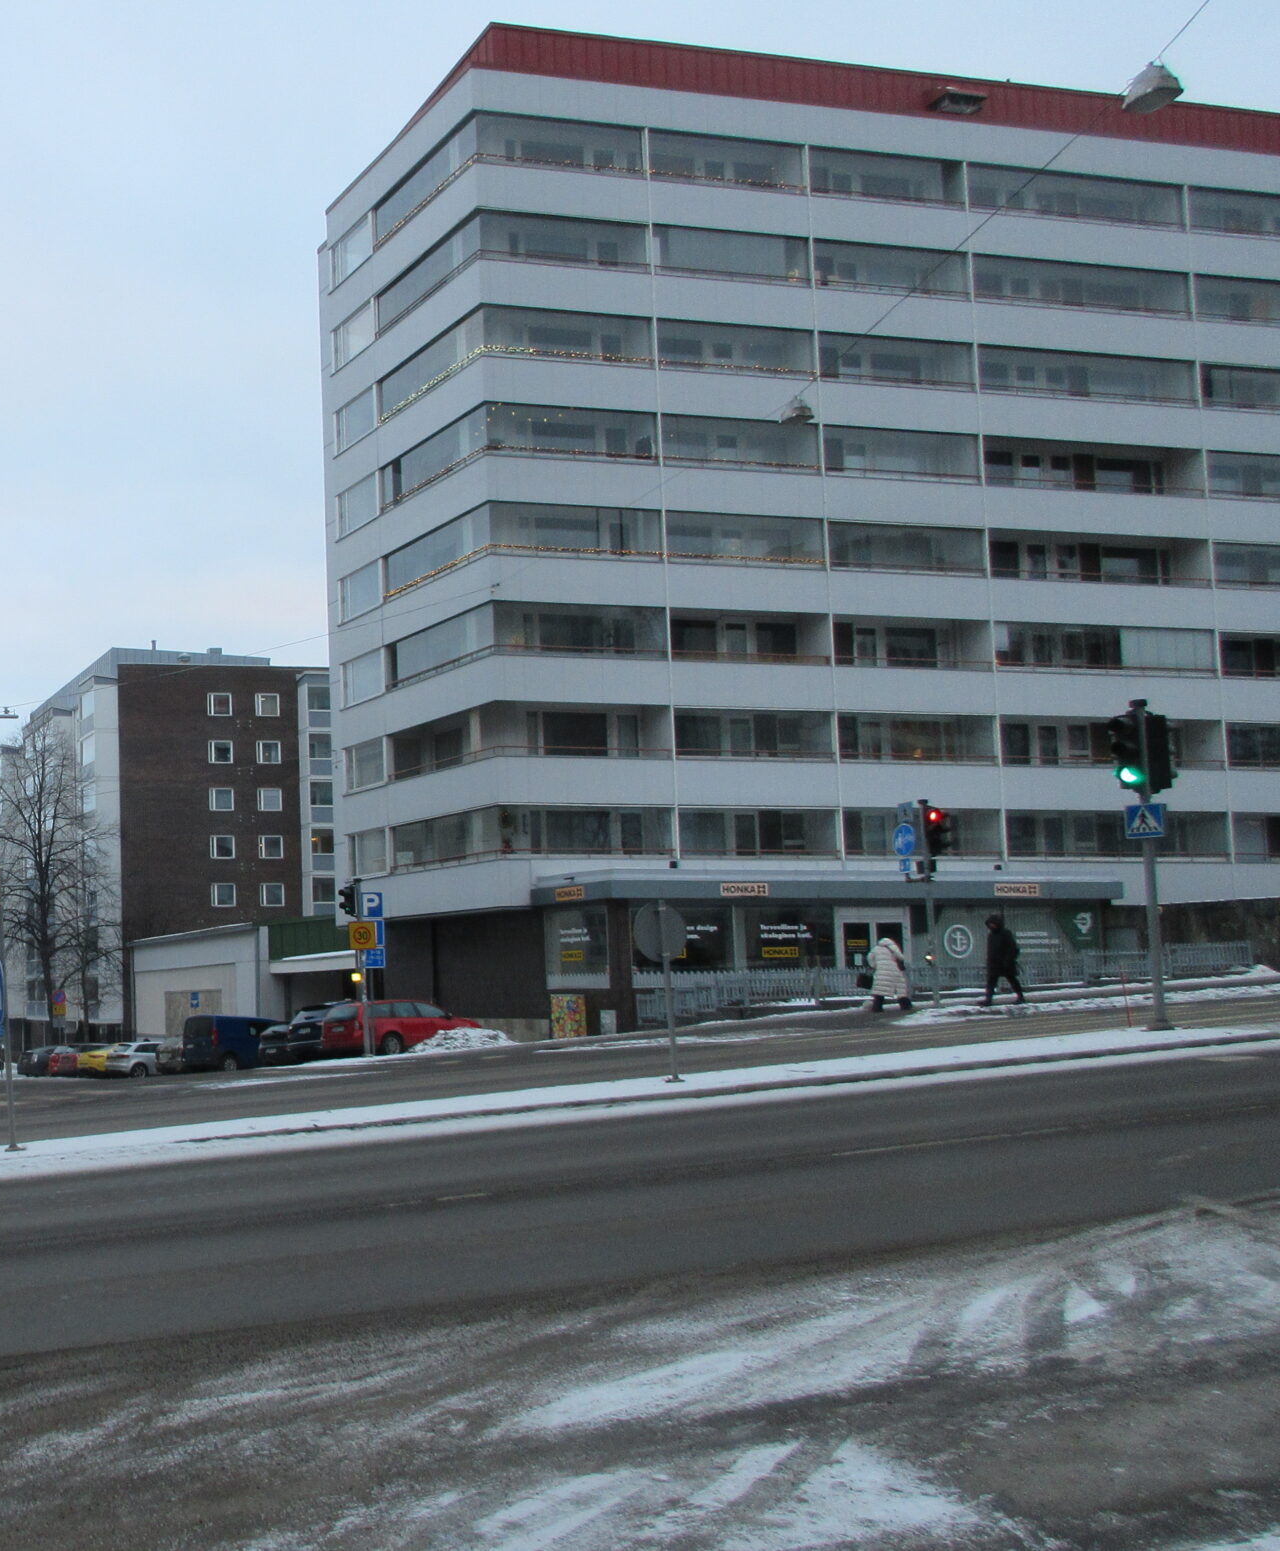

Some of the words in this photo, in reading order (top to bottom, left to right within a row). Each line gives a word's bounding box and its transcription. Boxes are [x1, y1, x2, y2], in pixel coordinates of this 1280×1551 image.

[722, 885, 756, 894] HONKA
[996, 885, 1027, 894] HONKA
[362, 893, 380, 917] P
[357, 930, 368, 941] 30
